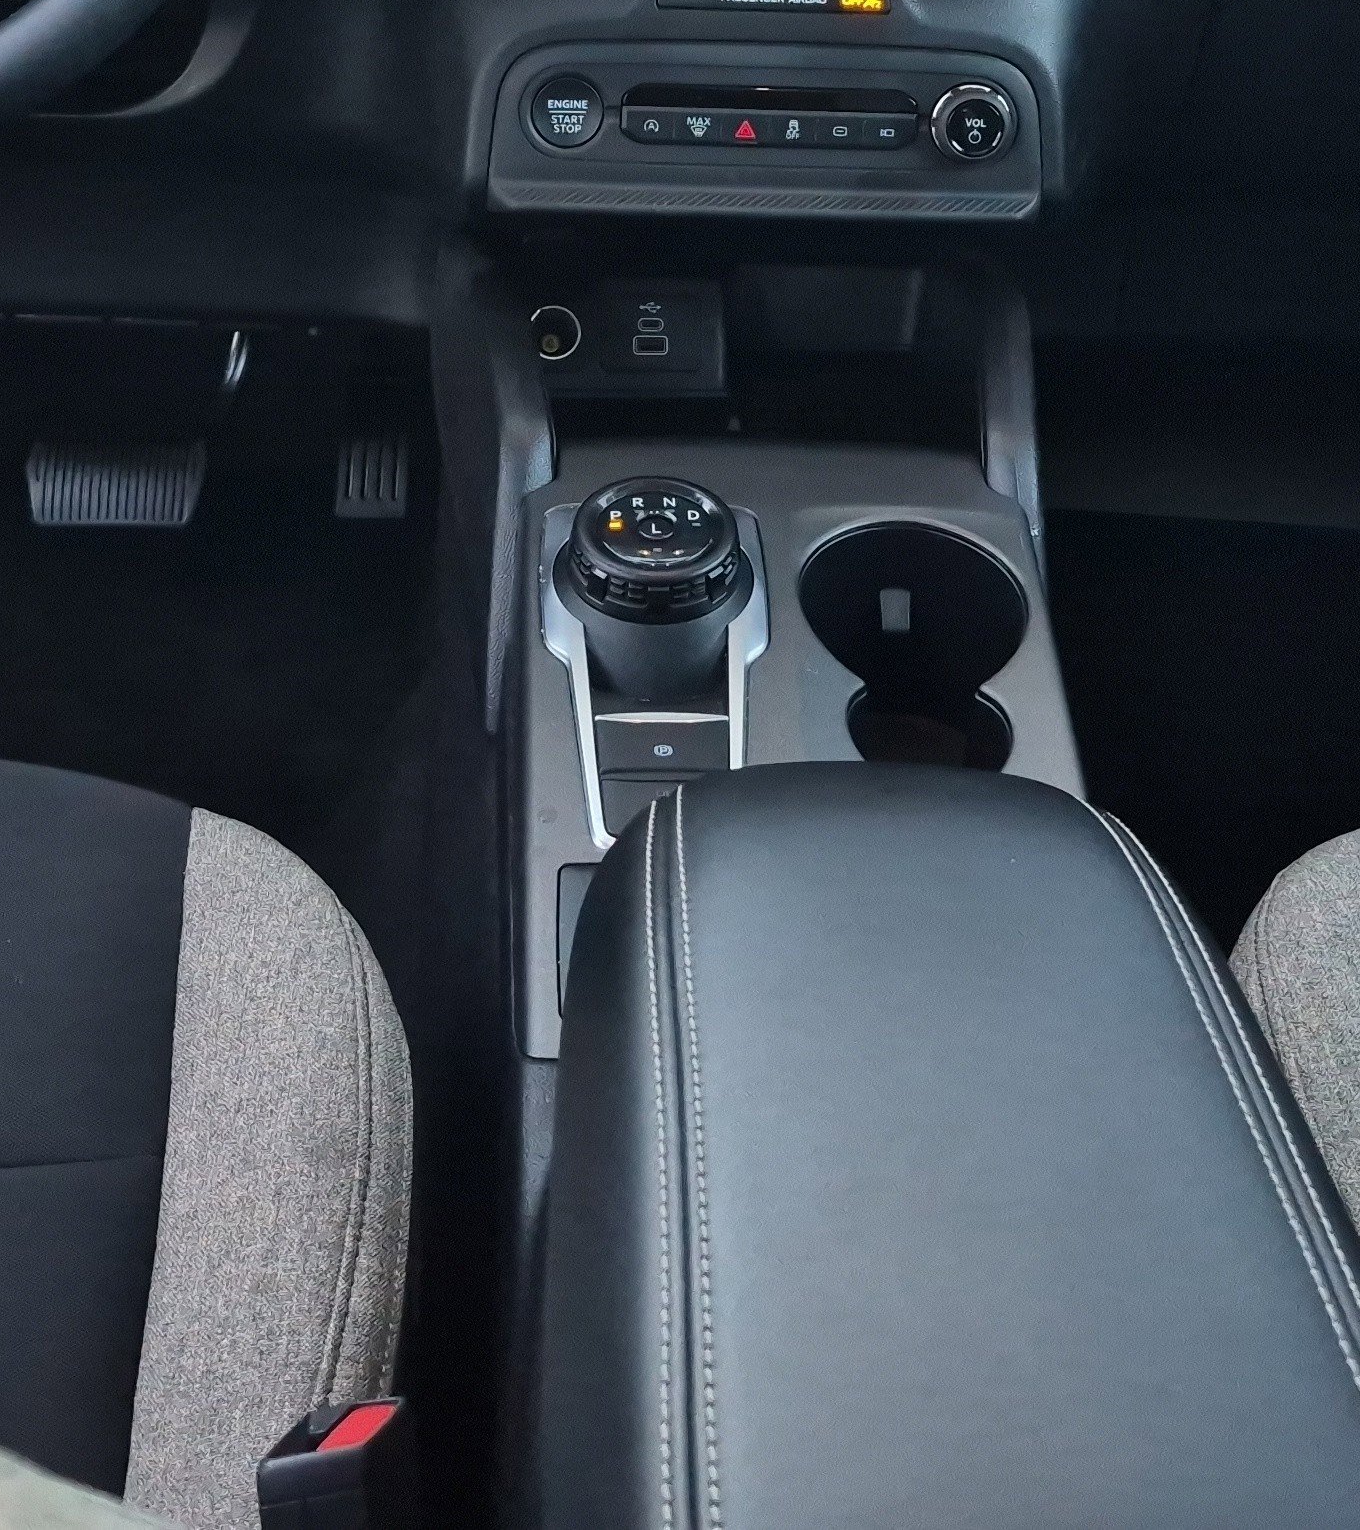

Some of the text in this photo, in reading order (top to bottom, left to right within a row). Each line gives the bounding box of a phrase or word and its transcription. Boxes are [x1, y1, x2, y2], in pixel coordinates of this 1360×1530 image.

[548, 100, 588, 110] ENGINE
[551, 115, 585, 125] START
[687, 117, 711, 126] MAX
[965, 118, 987, 128] VOL
[553, 124, 582, 134] STOP
[786, 132, 800, 140] OFF
[632, 498, 645, 508] R
[663, 497, 676, 508] N
[610, 511, 622, 521] P
[688, 510, 700, 521] D
[652, 523, 661, 534] L
